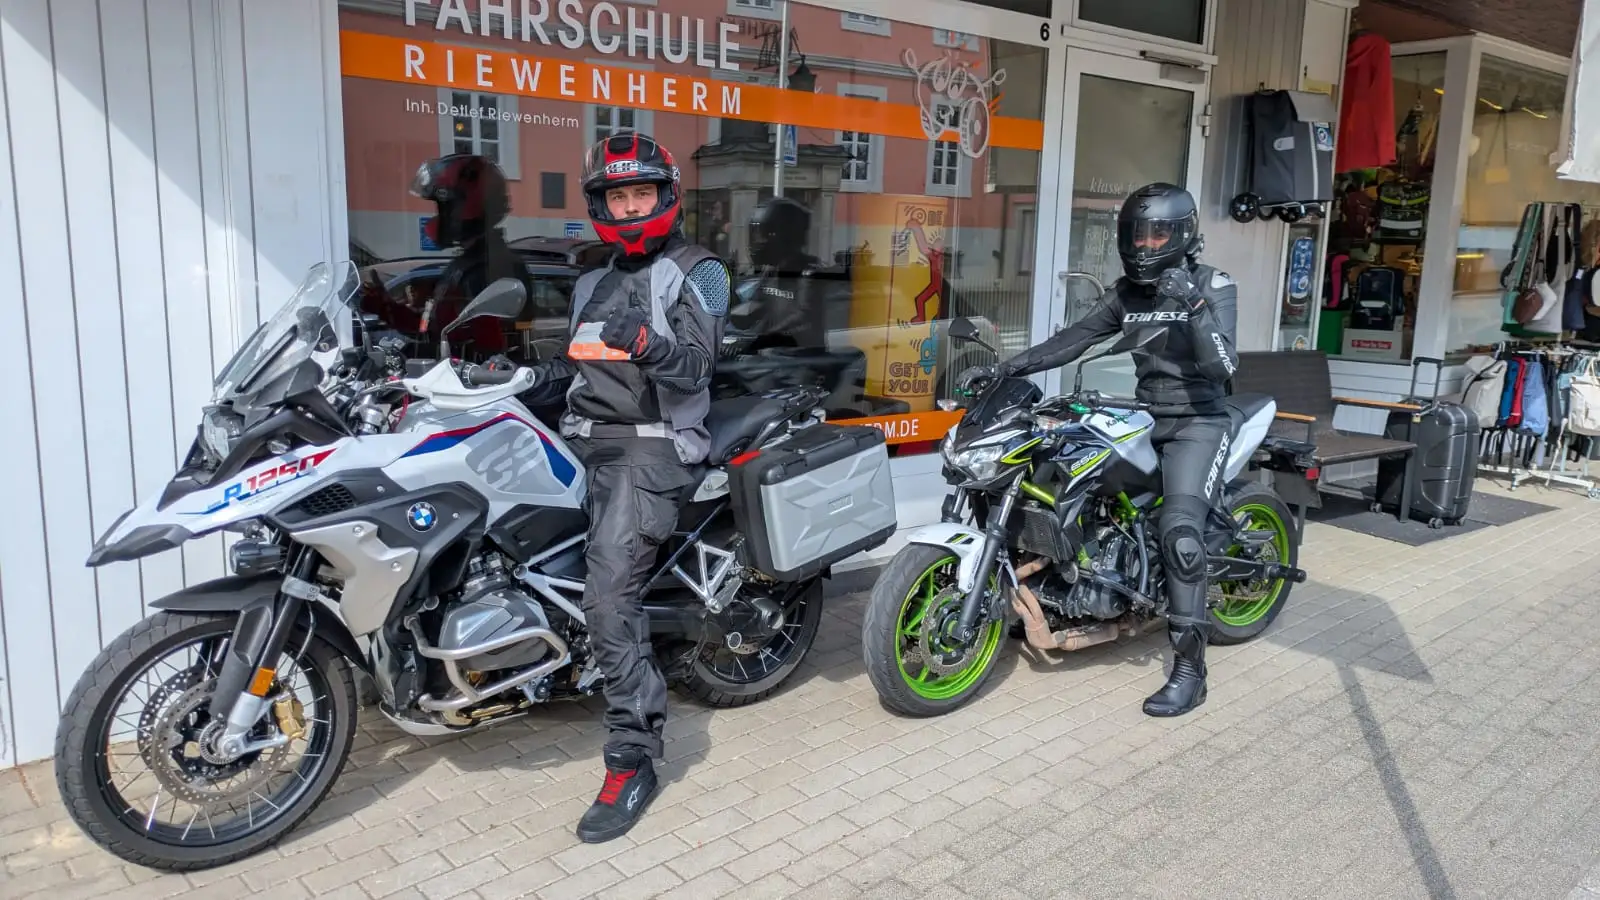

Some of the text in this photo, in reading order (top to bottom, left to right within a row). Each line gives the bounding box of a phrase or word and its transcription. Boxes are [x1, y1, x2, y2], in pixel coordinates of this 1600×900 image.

[1040, 23, 1050, 41] 6
[405, 44, 741, 115] RIEWENHERM
[406, 98, 579, 129] Inh. Detlef Riewenherm
[1123, 311, 1189, 323] DAINESE
[889, 362, 921, 378] GET
[888, 378, 928, 393] YOUR
[1204, 431, 1230, 499] DAINESE
